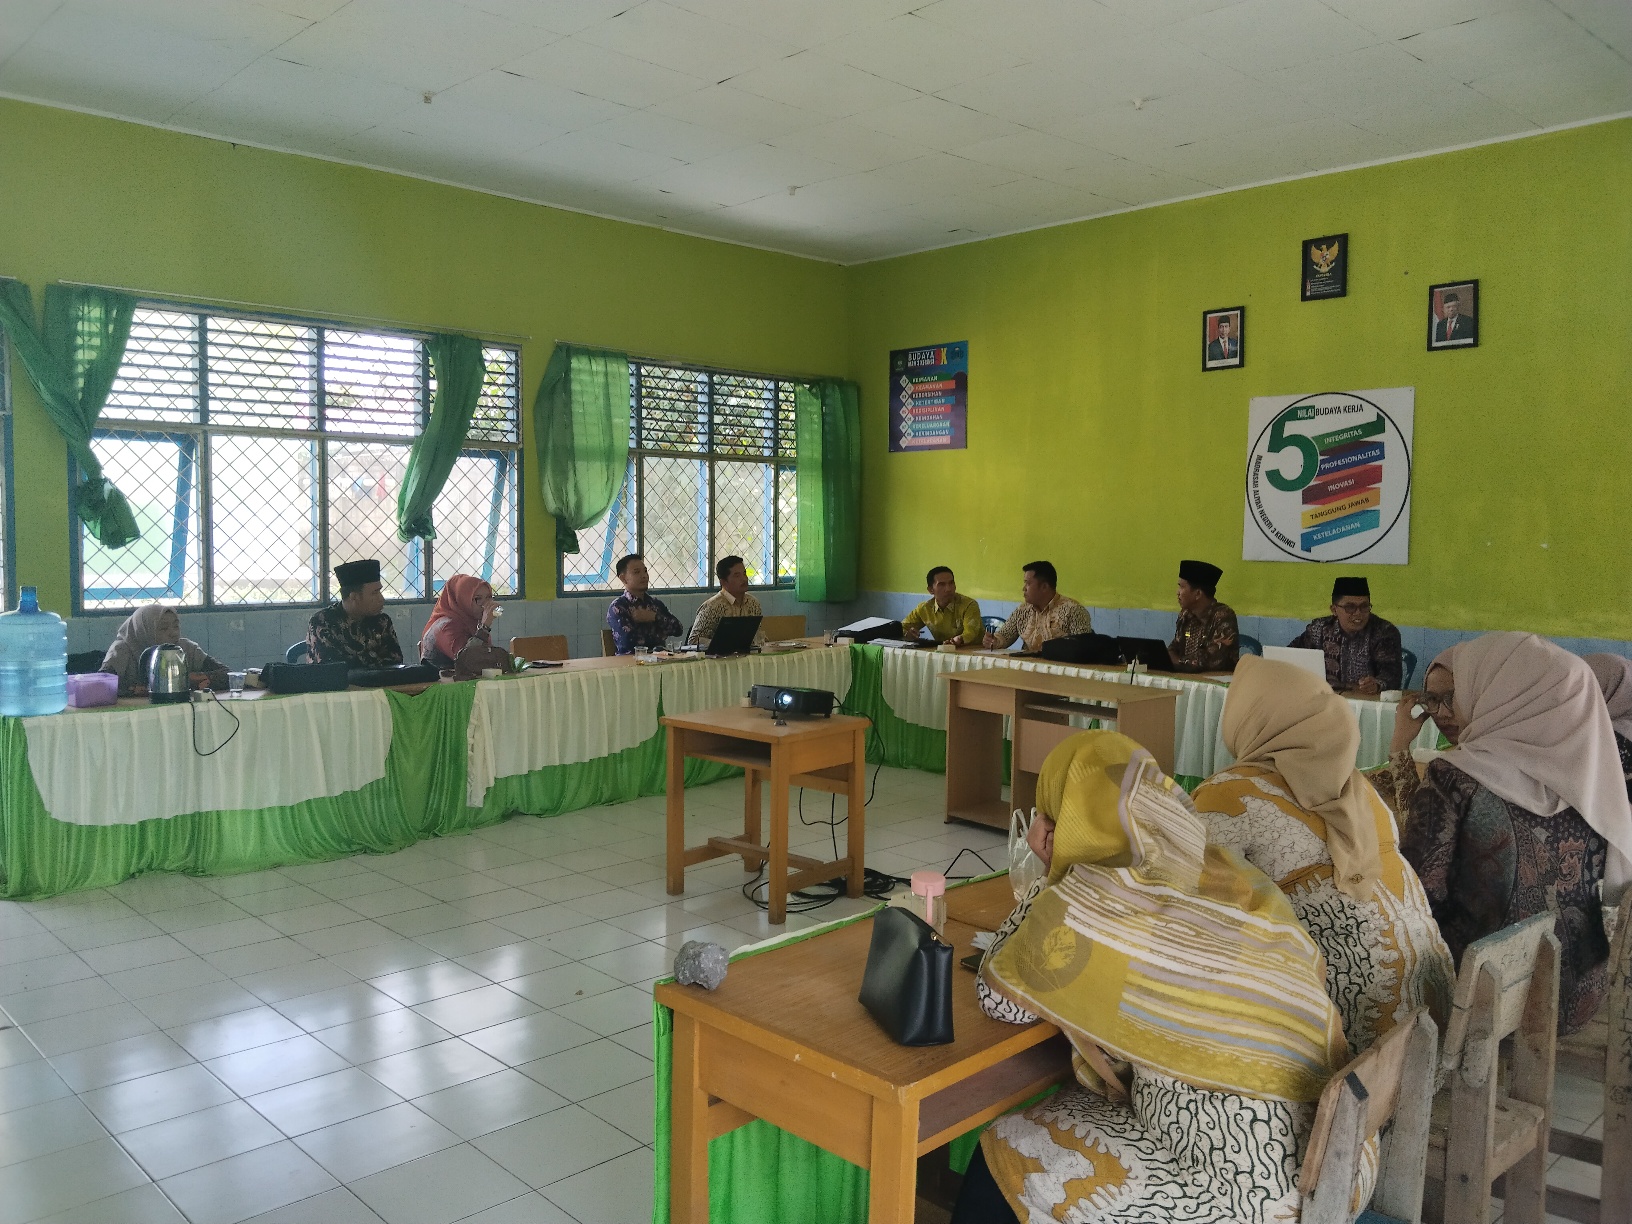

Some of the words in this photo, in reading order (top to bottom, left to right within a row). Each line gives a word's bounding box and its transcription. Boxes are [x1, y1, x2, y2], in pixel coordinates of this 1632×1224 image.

[908, 351, 935, 361] BUDAYA
[1297, 408, 1315, 418] NILAI
[1315, 406, 1342, 417] BUDAYA
[1342, 403, 1364, 414] KERJA
[1324, 428, 1363, 445] INTEGRITAS
[1265, 405, 1320, 492] 5
[1320, 448, 1380, 471] PROFESIONALITAS
[1253, 454, 1263, 488] MADRASAH
[1327, 478, 1355, 492] INOVASI
[1253, 489, 1263, 510] ALIYAH
[1309, 504, 1347, 520] TANGGUNG
[1347, 497, 1370, 509] JAWAB
[1258, 509, 1274, 530] NEGERI
[1274, 530, 1297, 549] KERINCI
[1312, 521, 1361, 541] KETELADANAN
